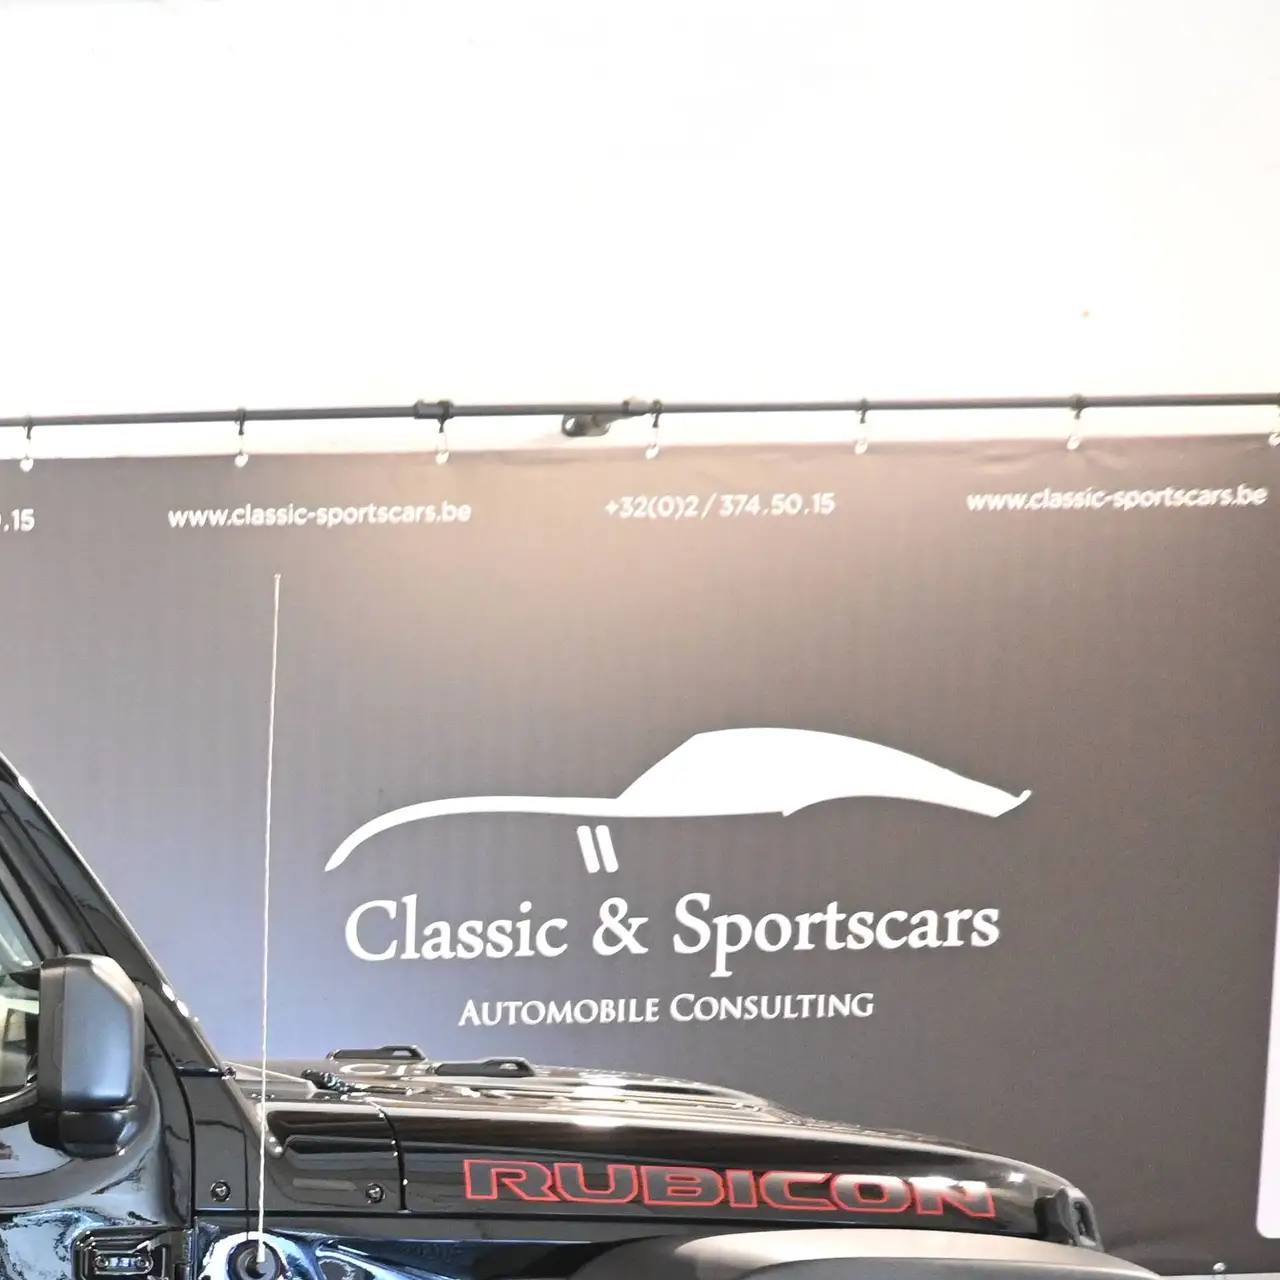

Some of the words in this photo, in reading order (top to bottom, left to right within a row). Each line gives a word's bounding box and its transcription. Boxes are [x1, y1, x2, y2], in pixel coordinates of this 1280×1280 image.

[965, 484, 1268, 511] www.classic-sportscars.be
[167, 502, 472, 529] www.classic-sportscars.be
[344, 893, 569, 963] Classic
[591, 896, 649, 956] &
[672, 892, 1002, 978] Sportscars
[457, 998, 660, 1027] AUTOMOBILE
[669, 992, 876, 1023] CONSULTING
[463, 1158, 996, 1218] RUBICON
